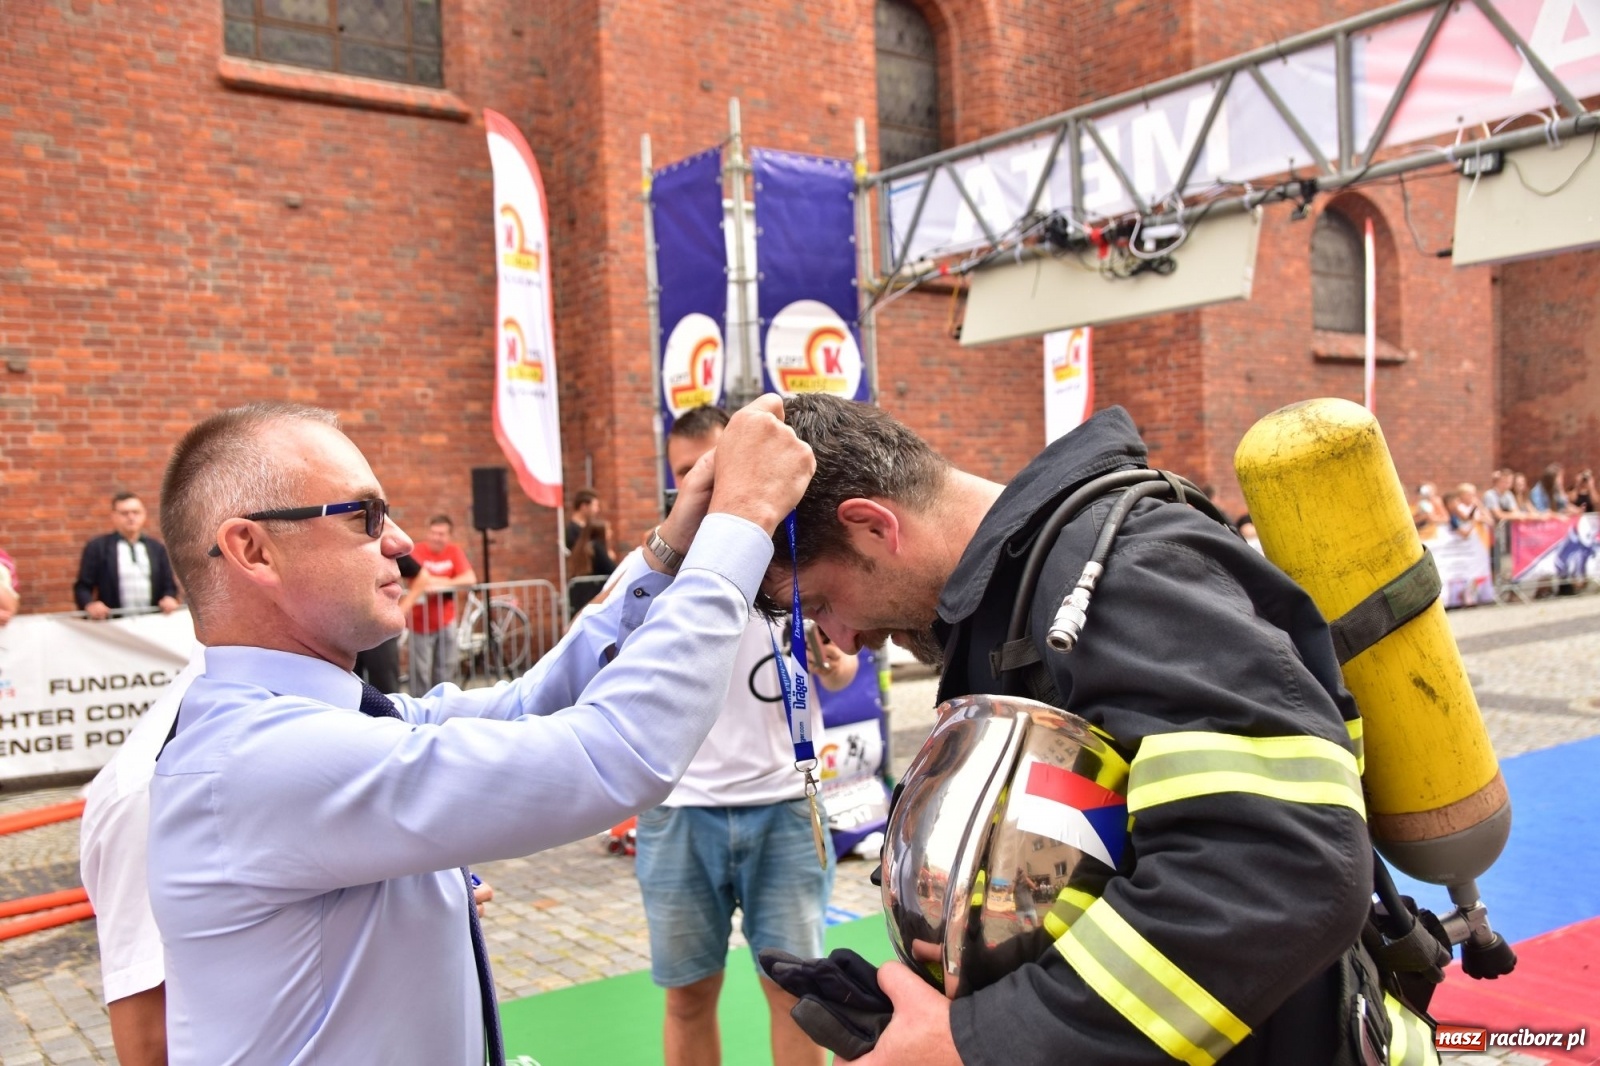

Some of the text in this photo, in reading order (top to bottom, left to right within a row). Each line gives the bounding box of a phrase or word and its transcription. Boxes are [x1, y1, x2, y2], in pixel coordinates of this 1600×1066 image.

[823, 347, 843, 375] K
[793, 672, 807, 710] Dräger
[86, 729, 131, 748] PO
